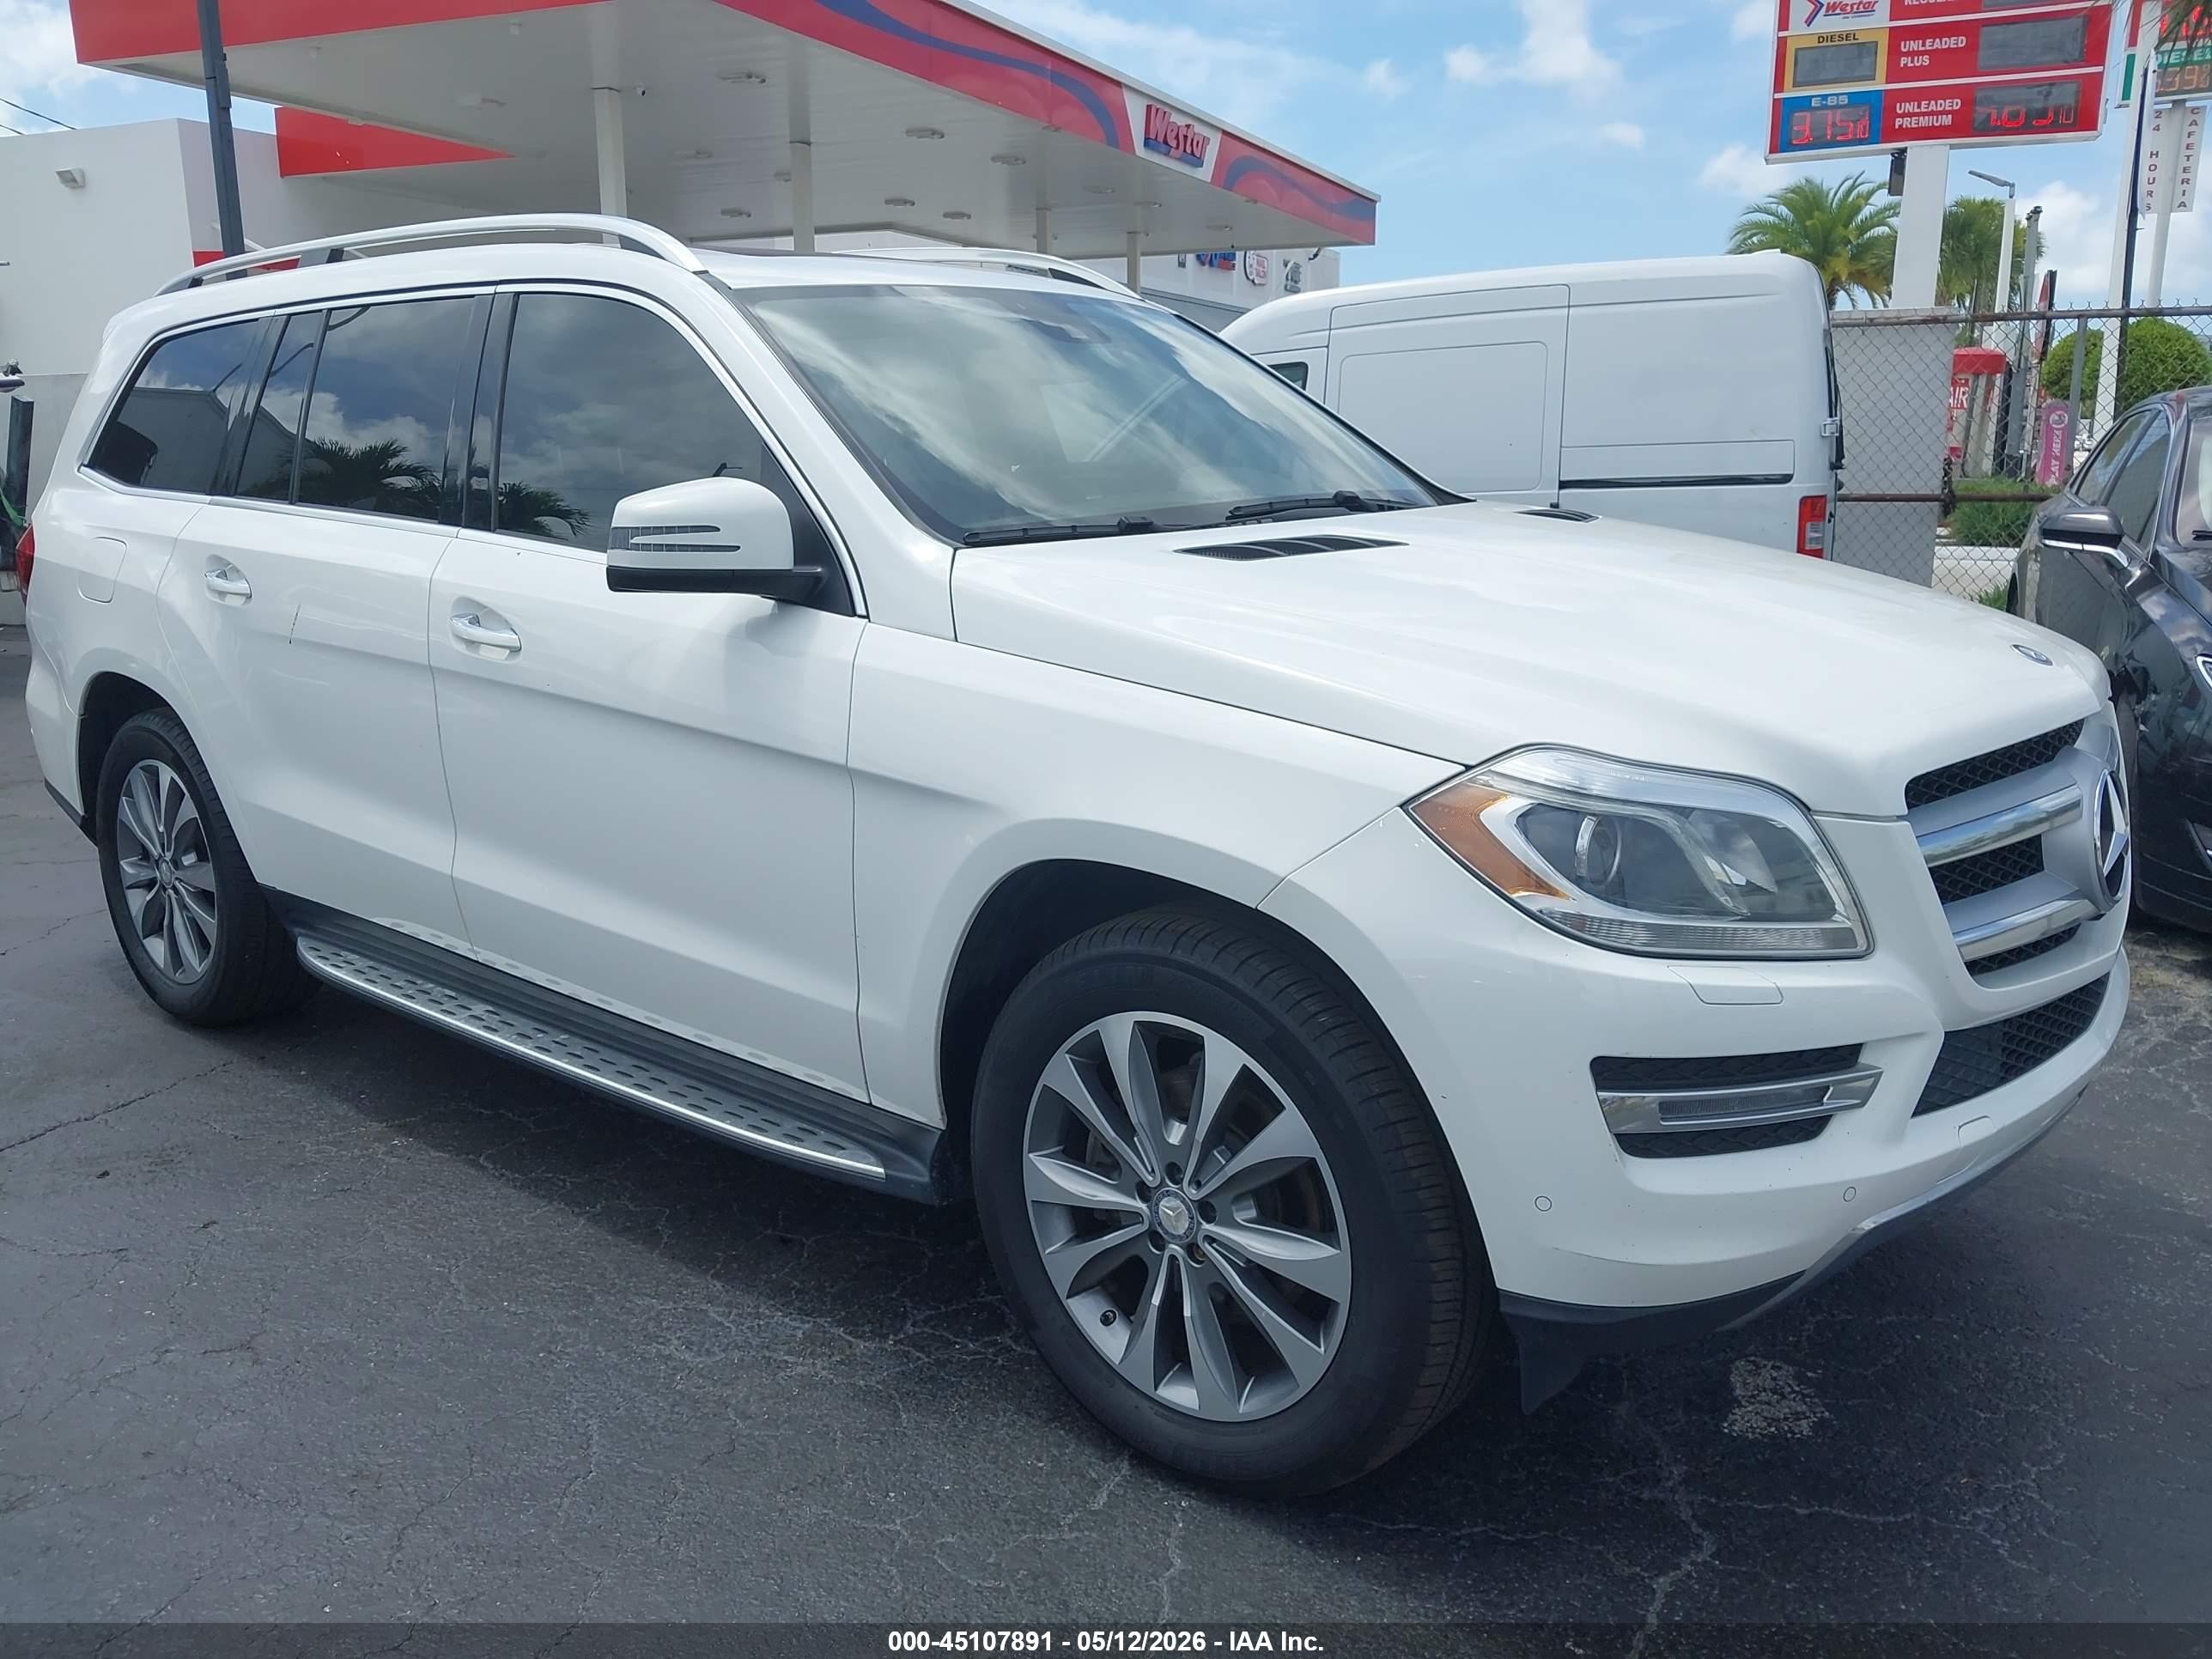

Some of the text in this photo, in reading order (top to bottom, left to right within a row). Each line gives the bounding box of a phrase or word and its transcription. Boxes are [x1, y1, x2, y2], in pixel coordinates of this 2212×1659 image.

[1824, 0, 1879, 15] Westar
[1818, 33, 1859, 44] DIESEL
[1900, 36, 1966, 52] UNLEADED
[1900, 55, 1929, 67] PLUS
[1811, 95, 1849, 107] E-85
[1896, 99, 1960, 113] UNLEADED
[1894, 114, 1953, 129] PREMIUM
[1146, 104, 1210, 161] Westar
[2145, 110, 2163, 211] 24 HOURS
[2177, 107, 2201, 209] CAFETERIA
